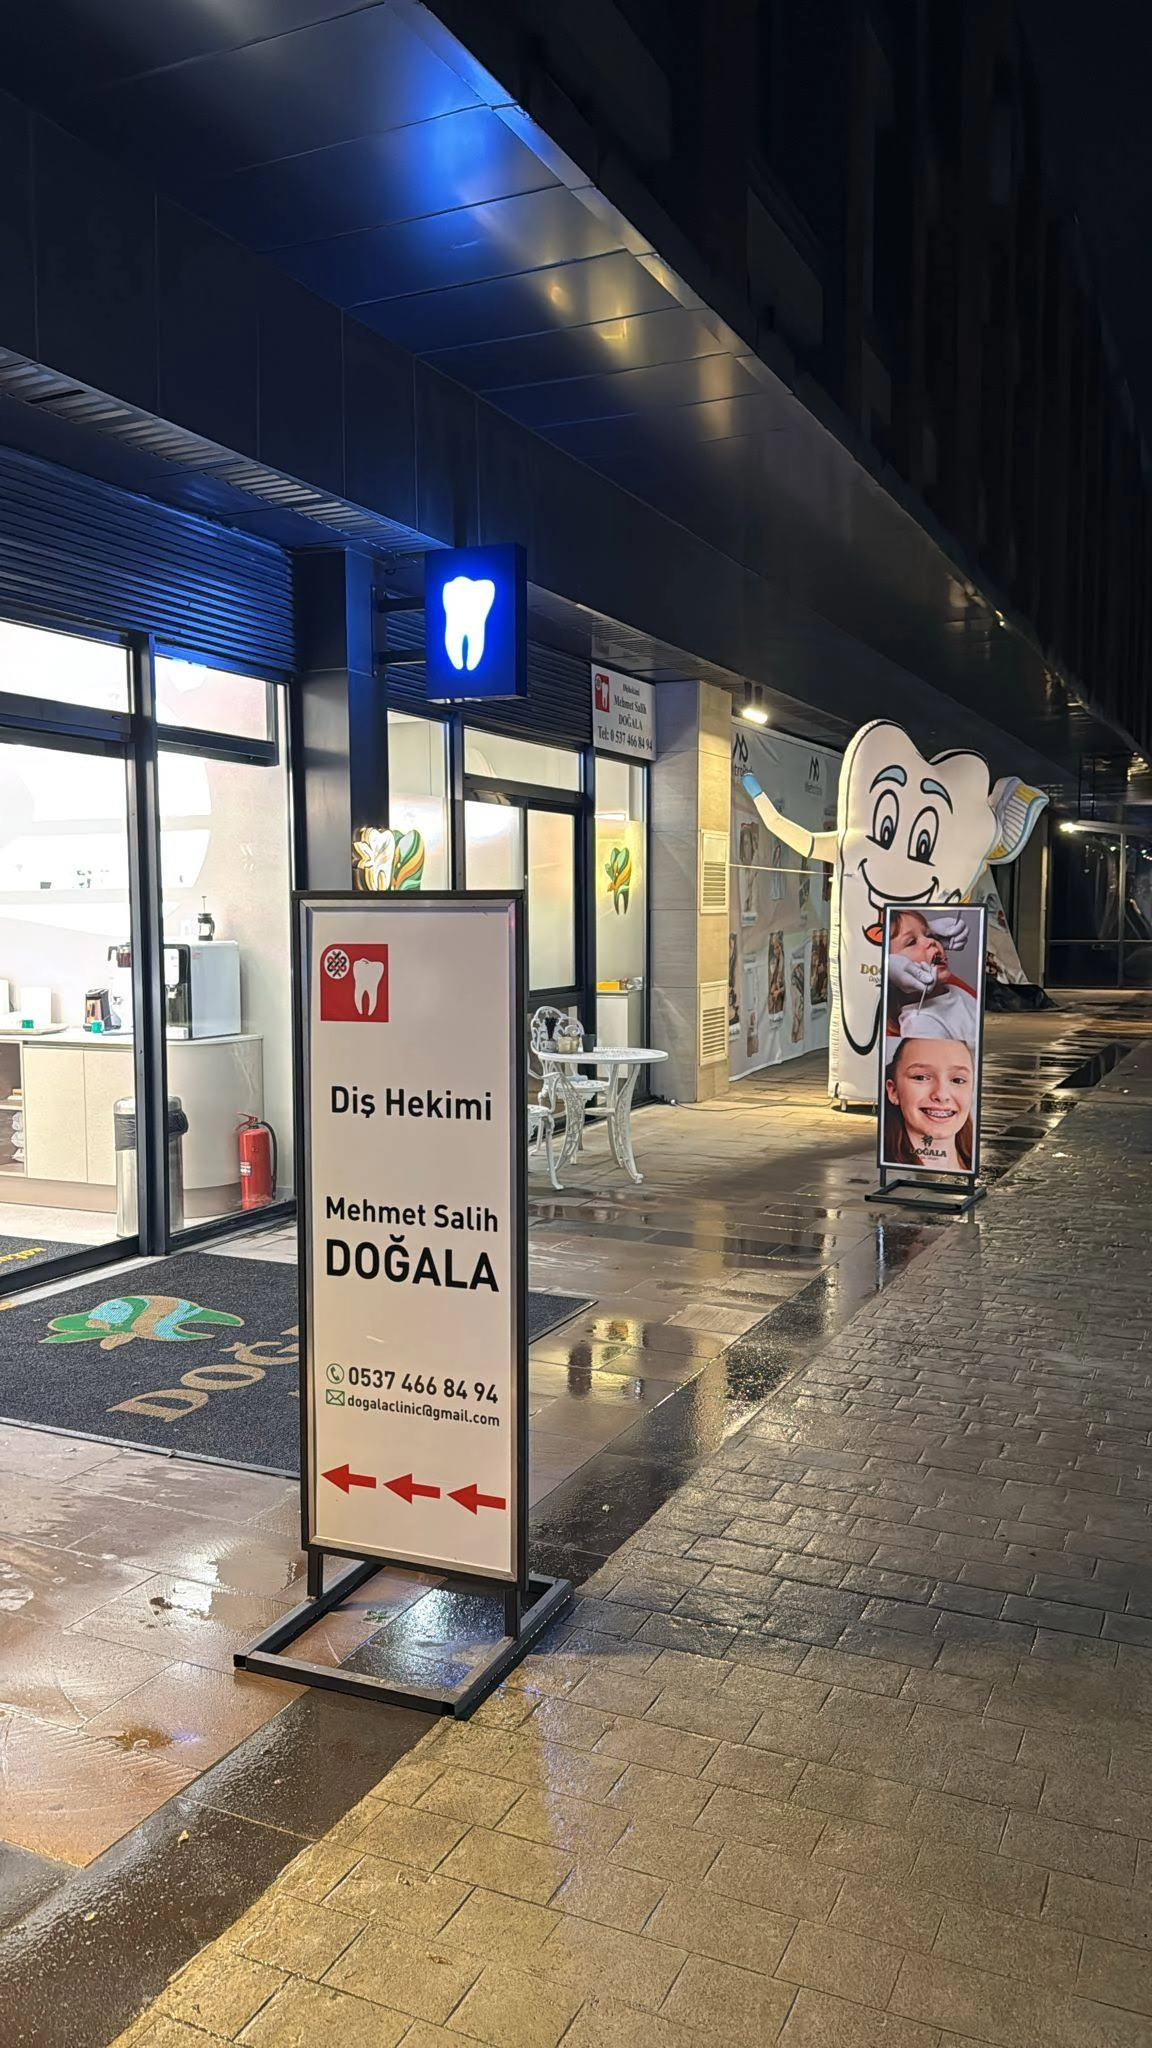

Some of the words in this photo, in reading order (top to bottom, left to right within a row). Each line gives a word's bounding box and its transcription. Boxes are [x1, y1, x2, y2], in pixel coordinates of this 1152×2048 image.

[614, 694, 634, 711] Mehmet
[634, 700, 647, 714] Salih
[598, 726, 609, 741] Tel:
[610, 729, 615, 742] 0
[615, 731, 626, 744] 537
[627, 733, 638, 747] 466
[638, 735, 645, 749] 84
[646, 738, 653, 751] 94
[618, 714, 643, 731] DOĞALA
[331, 1085, 376, 1119] Diş
[385, 1088, 492, 1121] Hekimi
[326, 1196, 426, 1227] Mehmet
[434, 1204, 498, 1232] Salih
[326, 1234, 500, 1293] DOĞALA
[105, 1325, 300, 1423] DOĞ
[348, 1366, 396, 1390] 0537
[401, 1373, 438, 1396] 466
[443, 1378, 468, 1400] 84
[474, 1382, 499, 1404] 94
[347, 1395, 500, 1427] dogalaclinic@gmail.com
